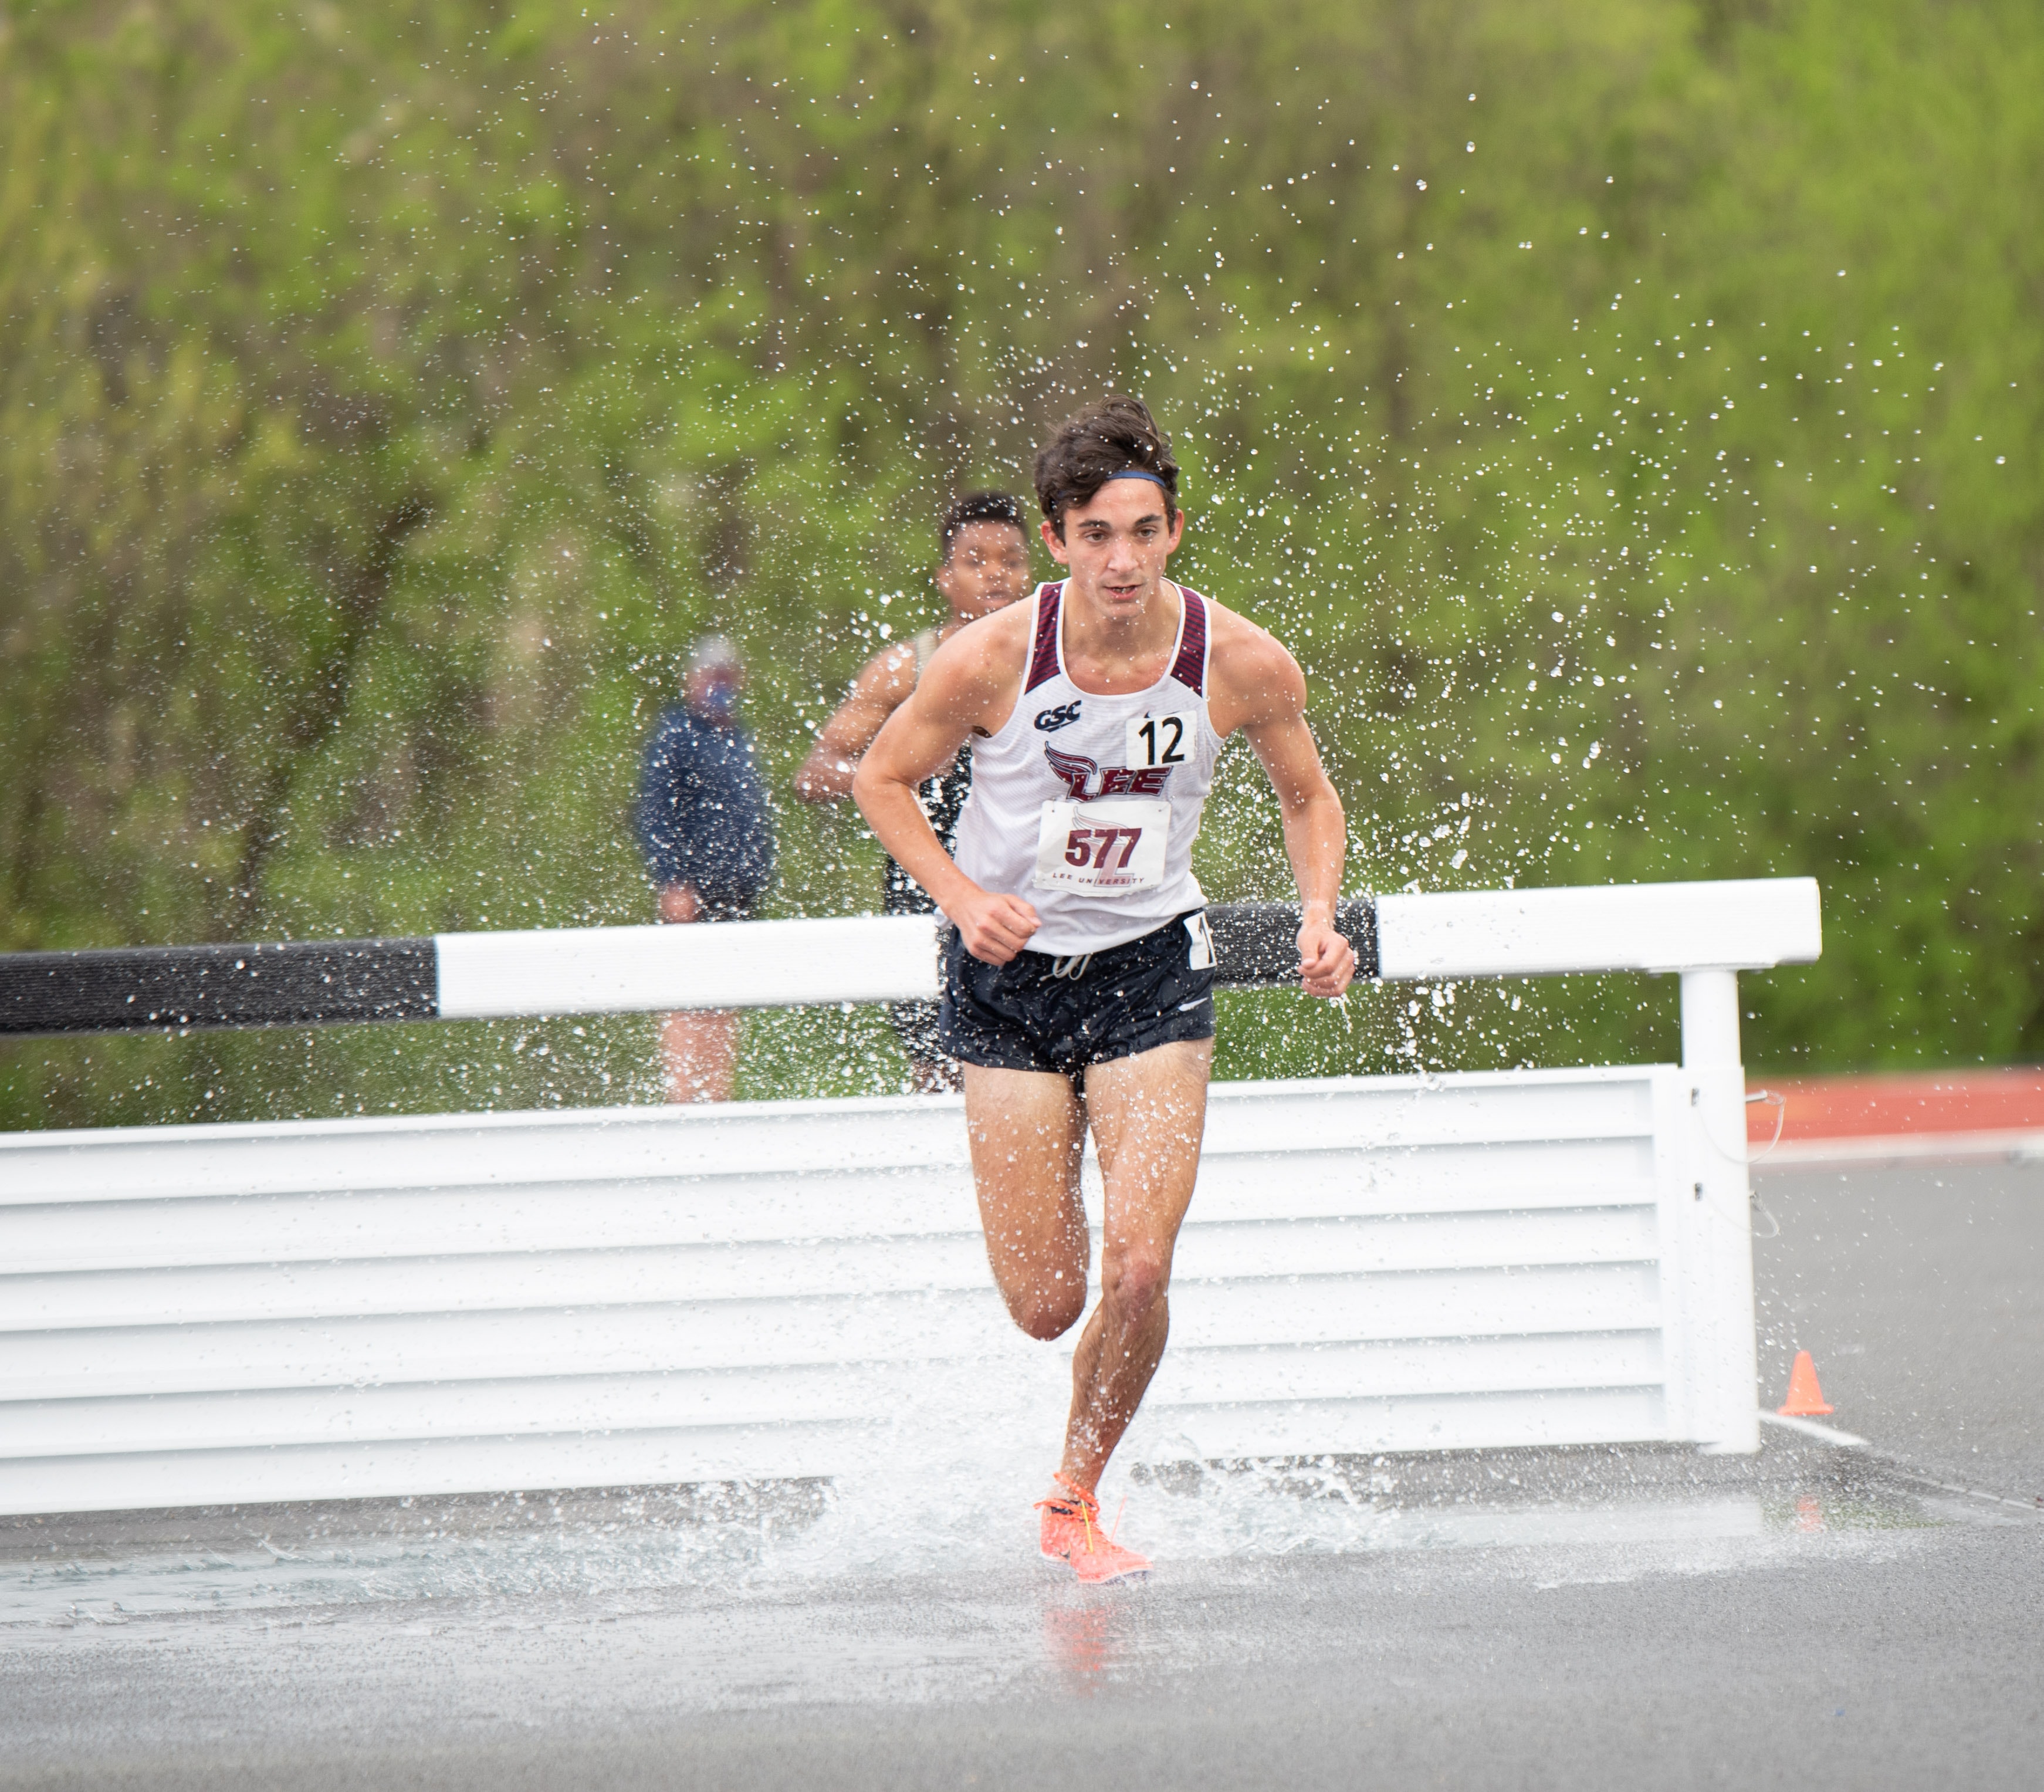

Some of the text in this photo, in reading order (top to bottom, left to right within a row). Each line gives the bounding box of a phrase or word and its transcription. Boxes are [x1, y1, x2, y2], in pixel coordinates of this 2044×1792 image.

[1034, 699, 1082, 731] GSC
[1139, 716, 1185, 765] 12
[1066, 765, 1173, 803] LEE
[1065, 828, 1142, 869] 577
[1078, 877, 1145, 885] UNIVERSITY
